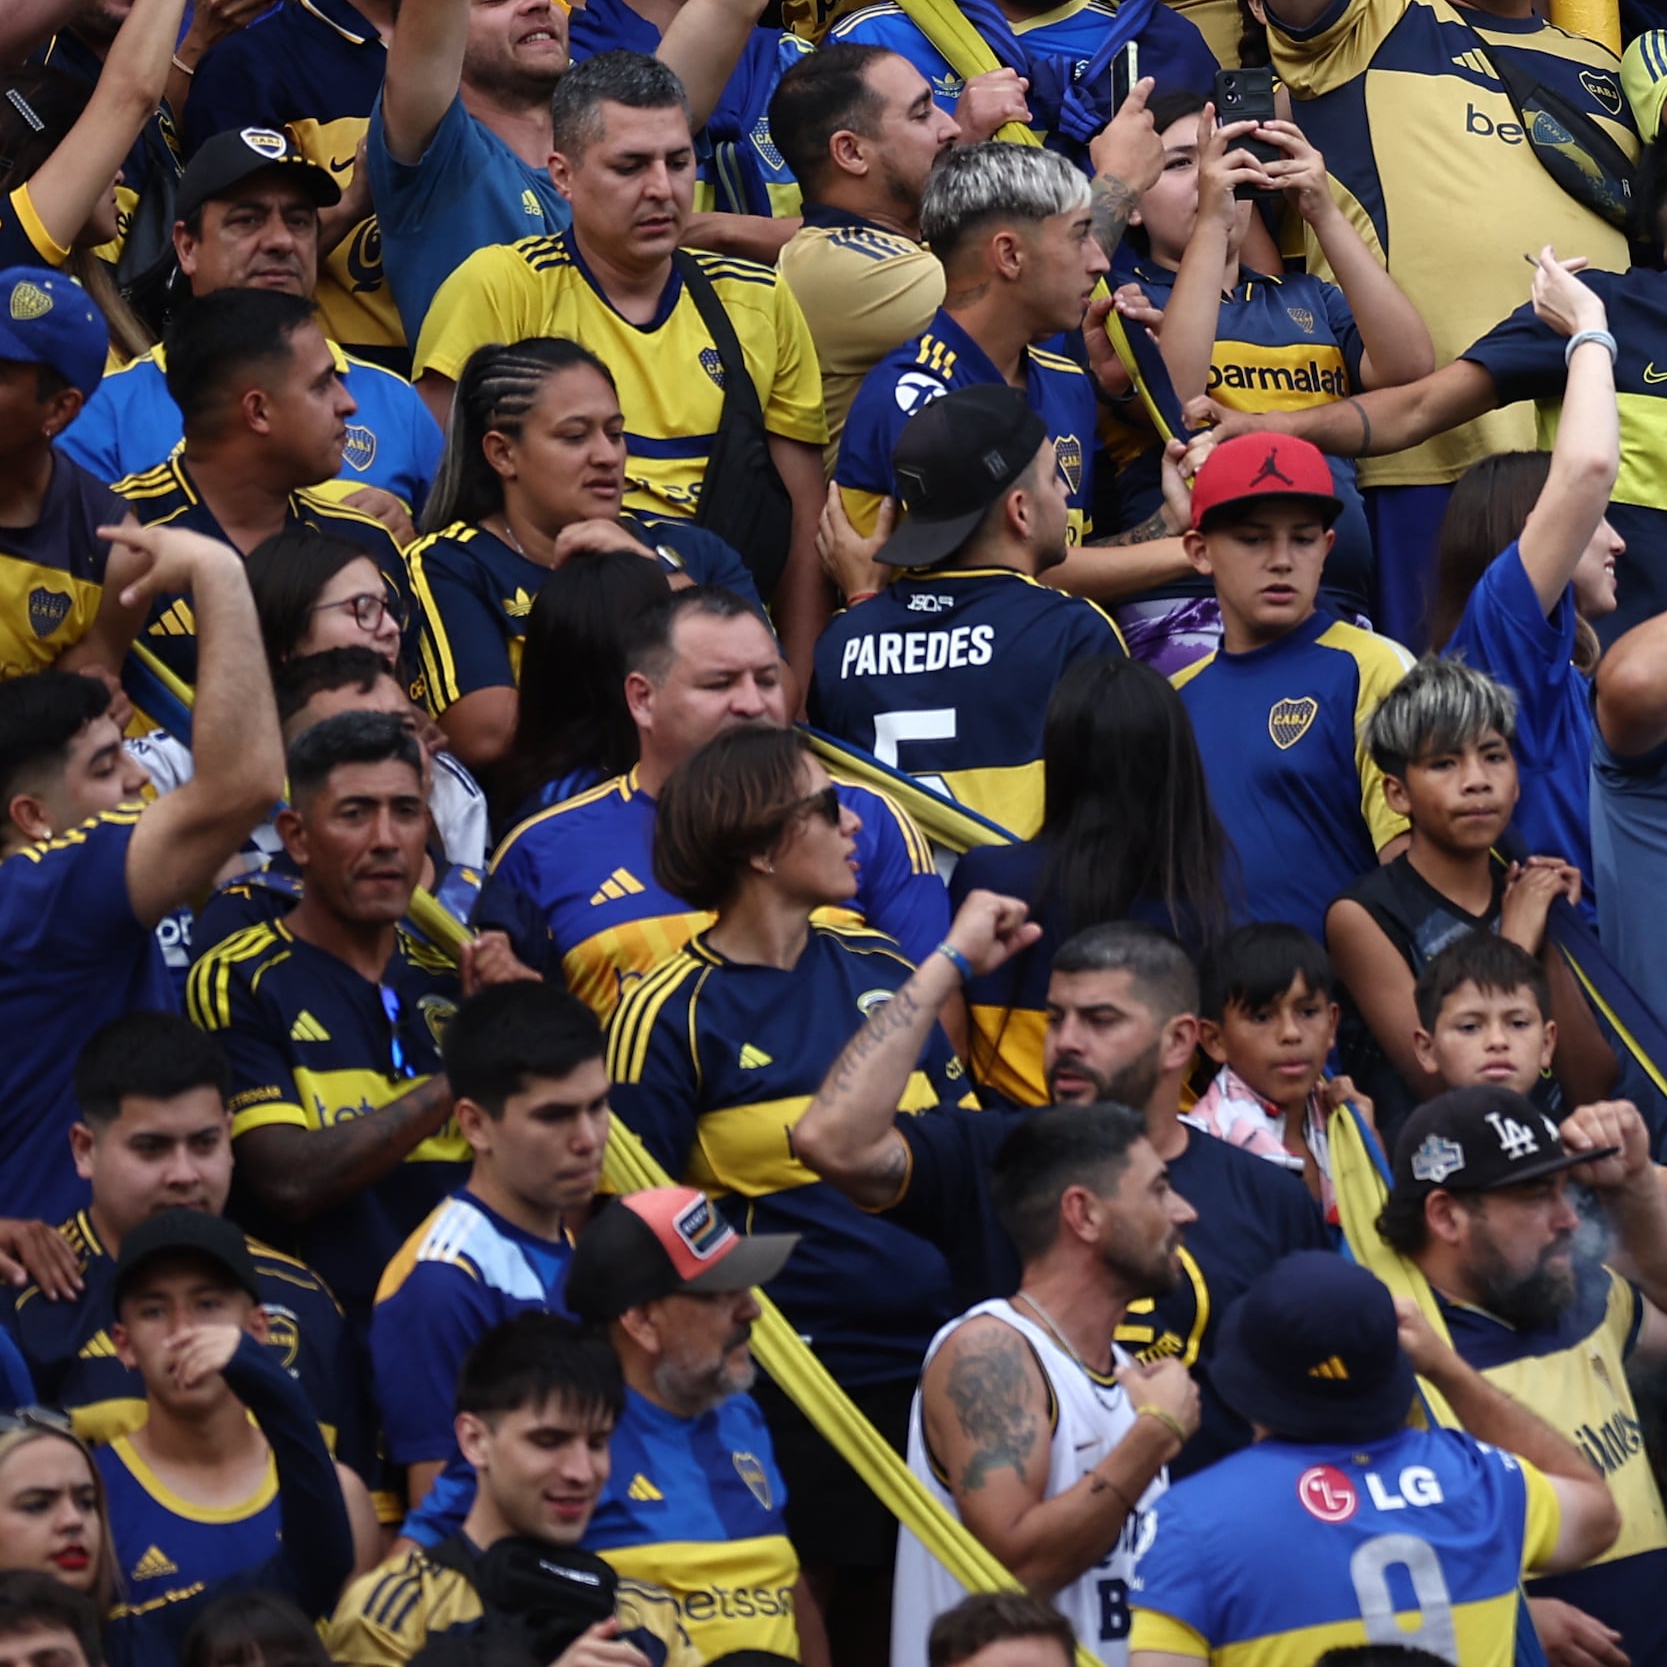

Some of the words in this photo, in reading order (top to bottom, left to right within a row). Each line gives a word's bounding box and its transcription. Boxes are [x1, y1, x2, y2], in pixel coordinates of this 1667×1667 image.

[840, 625, 995, 679] PAREDES
[1273, 713, 1307, 726] CABJ
[1484, 1112, 1539, 1160] LA
[1365, 1463, 1446, 1512] LG
[684, 1583, 795, 1622] etss
